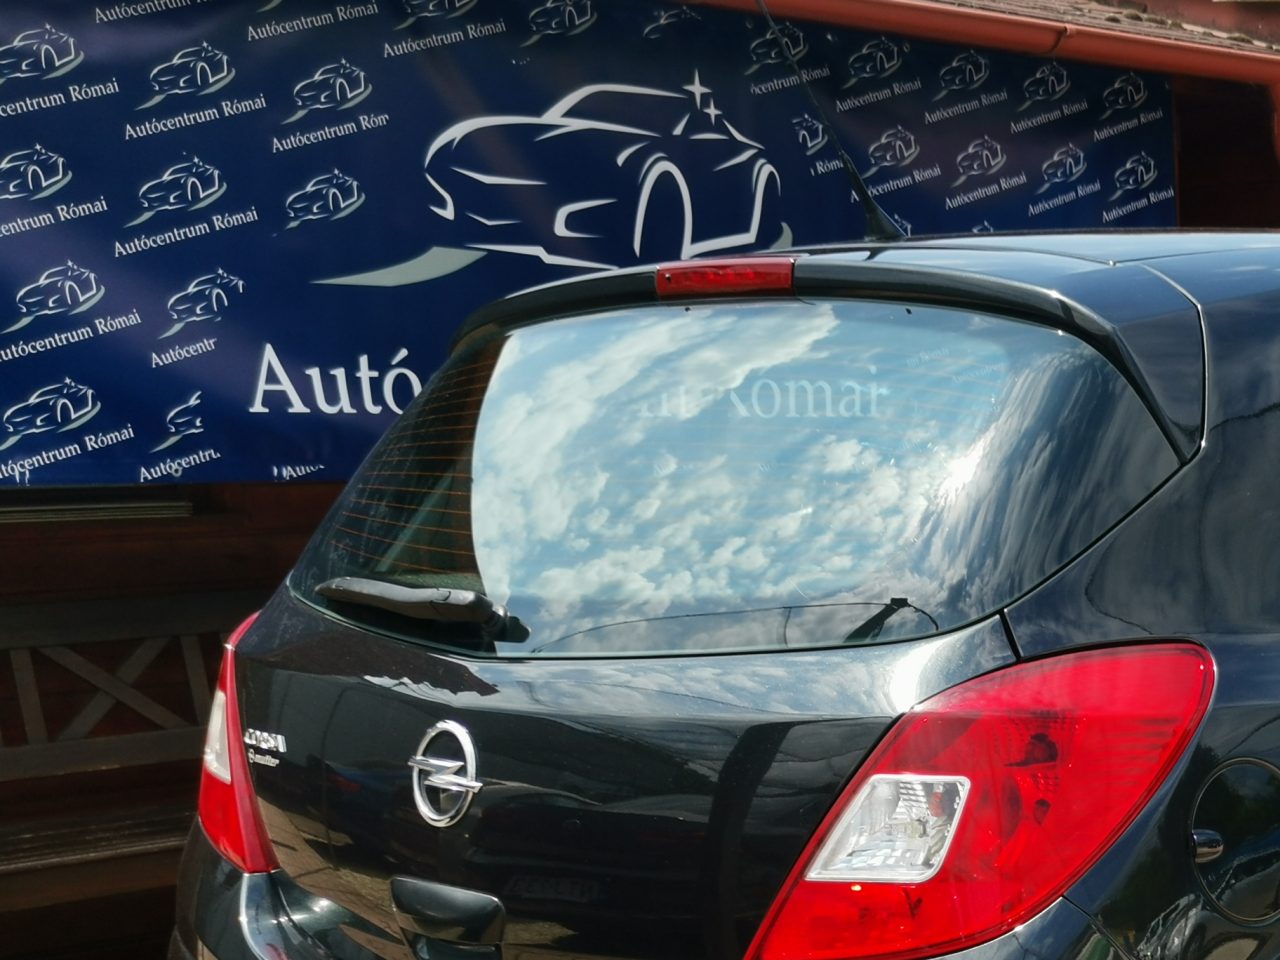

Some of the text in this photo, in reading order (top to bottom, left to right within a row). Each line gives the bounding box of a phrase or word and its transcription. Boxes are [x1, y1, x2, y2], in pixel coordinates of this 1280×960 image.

[247, 1, 379, 42] Autócentrum Római
[384, 19, 506, 58] Autócentrum Római
[69, 77, 119, 102] Római
[125, 94, 266, 139] Autócentrum Római
[272, 122, 357, 153] Autócentrum
[56, 195, 108, 221] Római
[114, 206, 259, 257] Autócentrum Római
[0, 308, 142, 362] utócentrum Római
[248, 342, 423, 415] Autó
[0, 424, 135, 479] tócentrum Római
